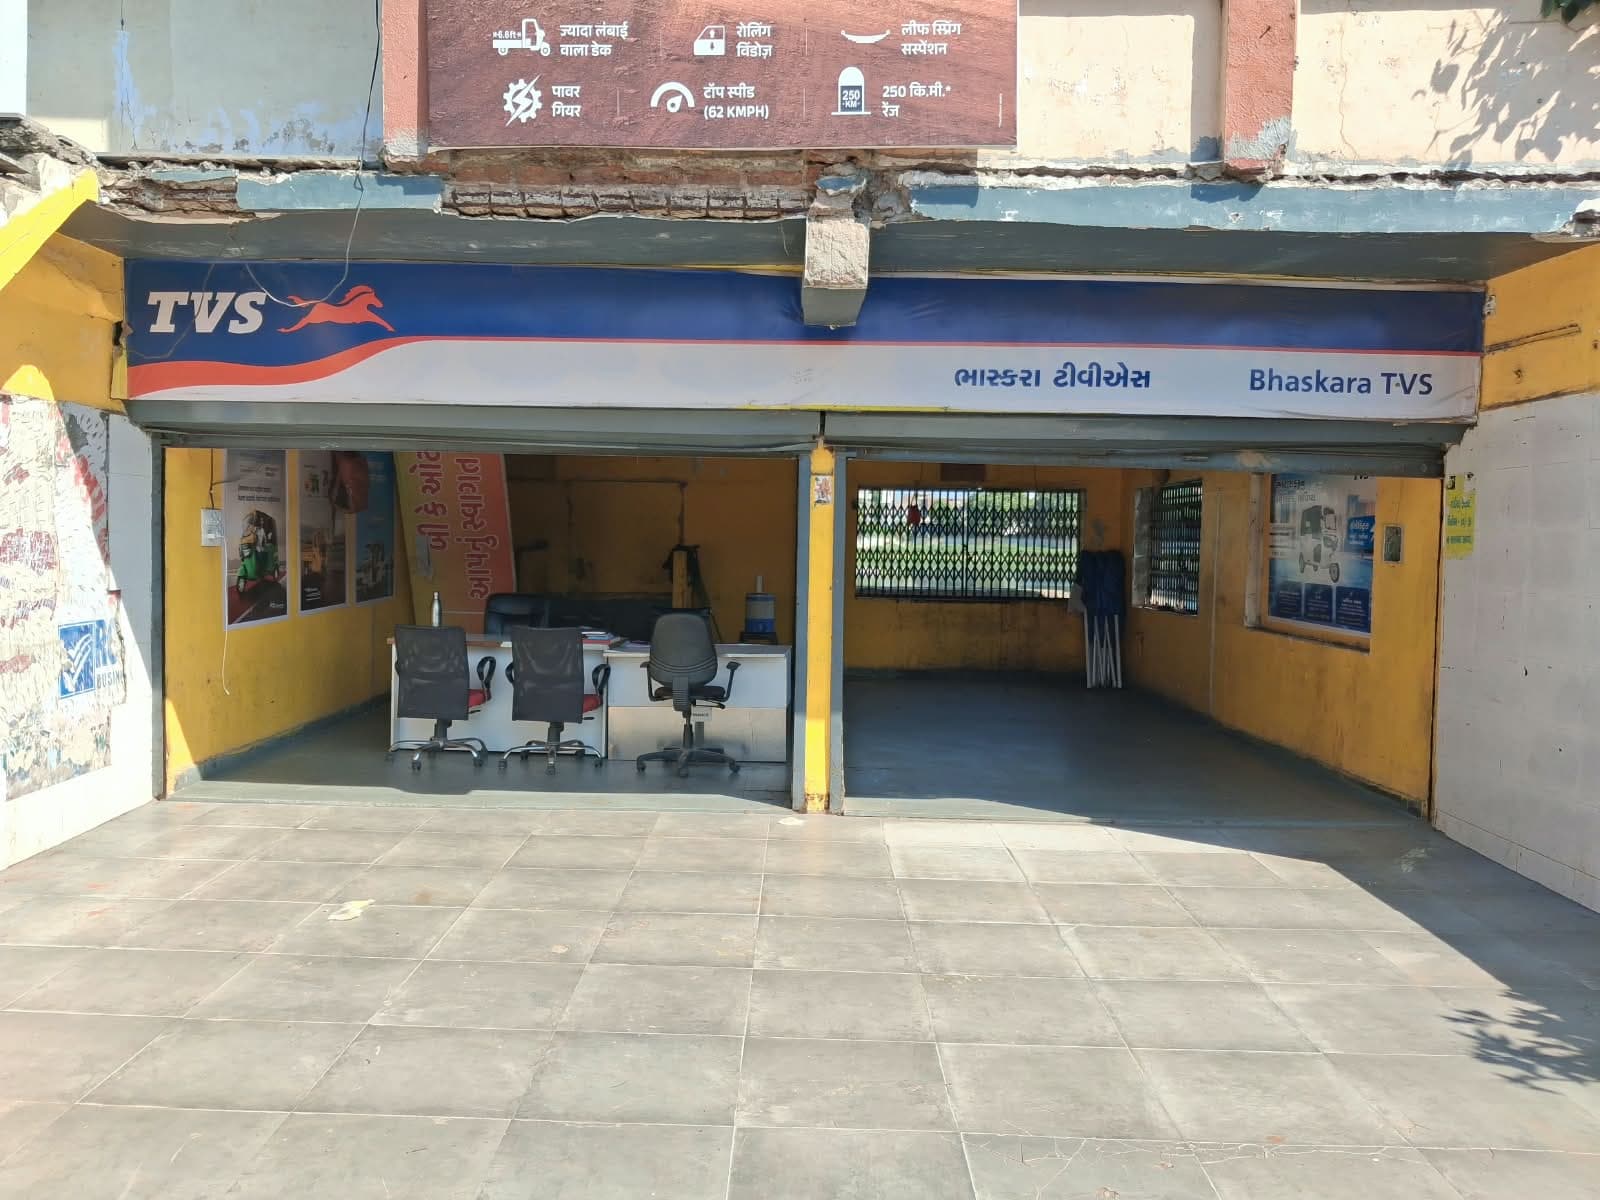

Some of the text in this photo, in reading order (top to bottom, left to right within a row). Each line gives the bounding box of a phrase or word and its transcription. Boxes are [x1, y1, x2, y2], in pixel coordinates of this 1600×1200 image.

[560, 21, 629, 40] ज्यादा लंबाई
[735, 21, 772, 37] रोलिंग
[901, 20, 962, 35] लीफ स्प्रिंग
[560, 41, 613, 57] वाला डेक
[736, 41, 773, 58] विंडोज़
[901, 40, 948, 55] सस्पेंशन
[552, 85, 581, 98] पावर
[703, 82, 755, 99] टॉप स्पीड
[842, 90, 861, 101] 250
[882, 85, 907, 98] 250
[552, 101, 582, 117] गियर
[703, 104, 769, 120] (62 KMPH)
[881, 103, 900, 118] रेंज
[147, 291, 267, 335] TVS
[954, 361, 1151, 389] ભાસ્કરા ટીવીએસ
[1249, 367, 1433, 396] Bhaskara TVS
